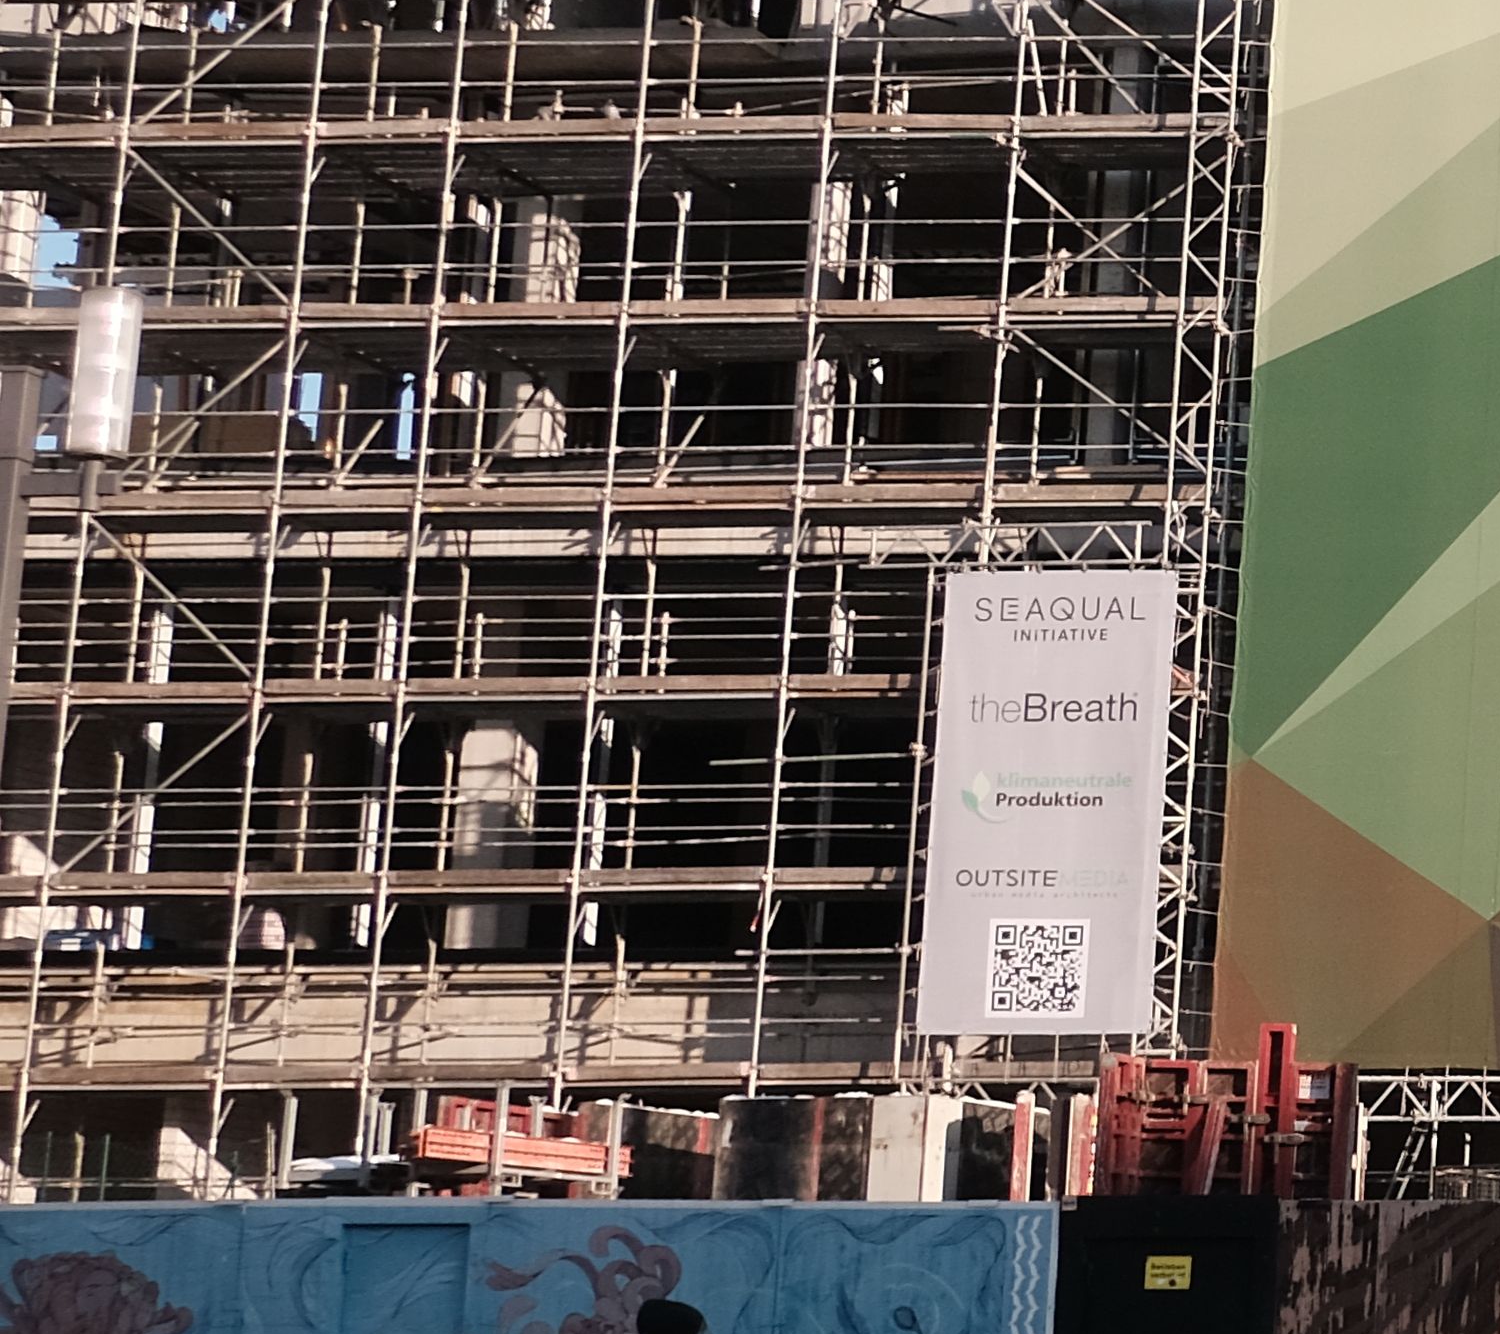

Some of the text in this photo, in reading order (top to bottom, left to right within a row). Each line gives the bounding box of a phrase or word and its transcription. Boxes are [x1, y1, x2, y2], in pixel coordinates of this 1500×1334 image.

[974, 596, 1146, 622] SEAQUAL
[996, 771, 1133, 788] klimaneutrale
[995, 791, 1104, 807] Produktion
